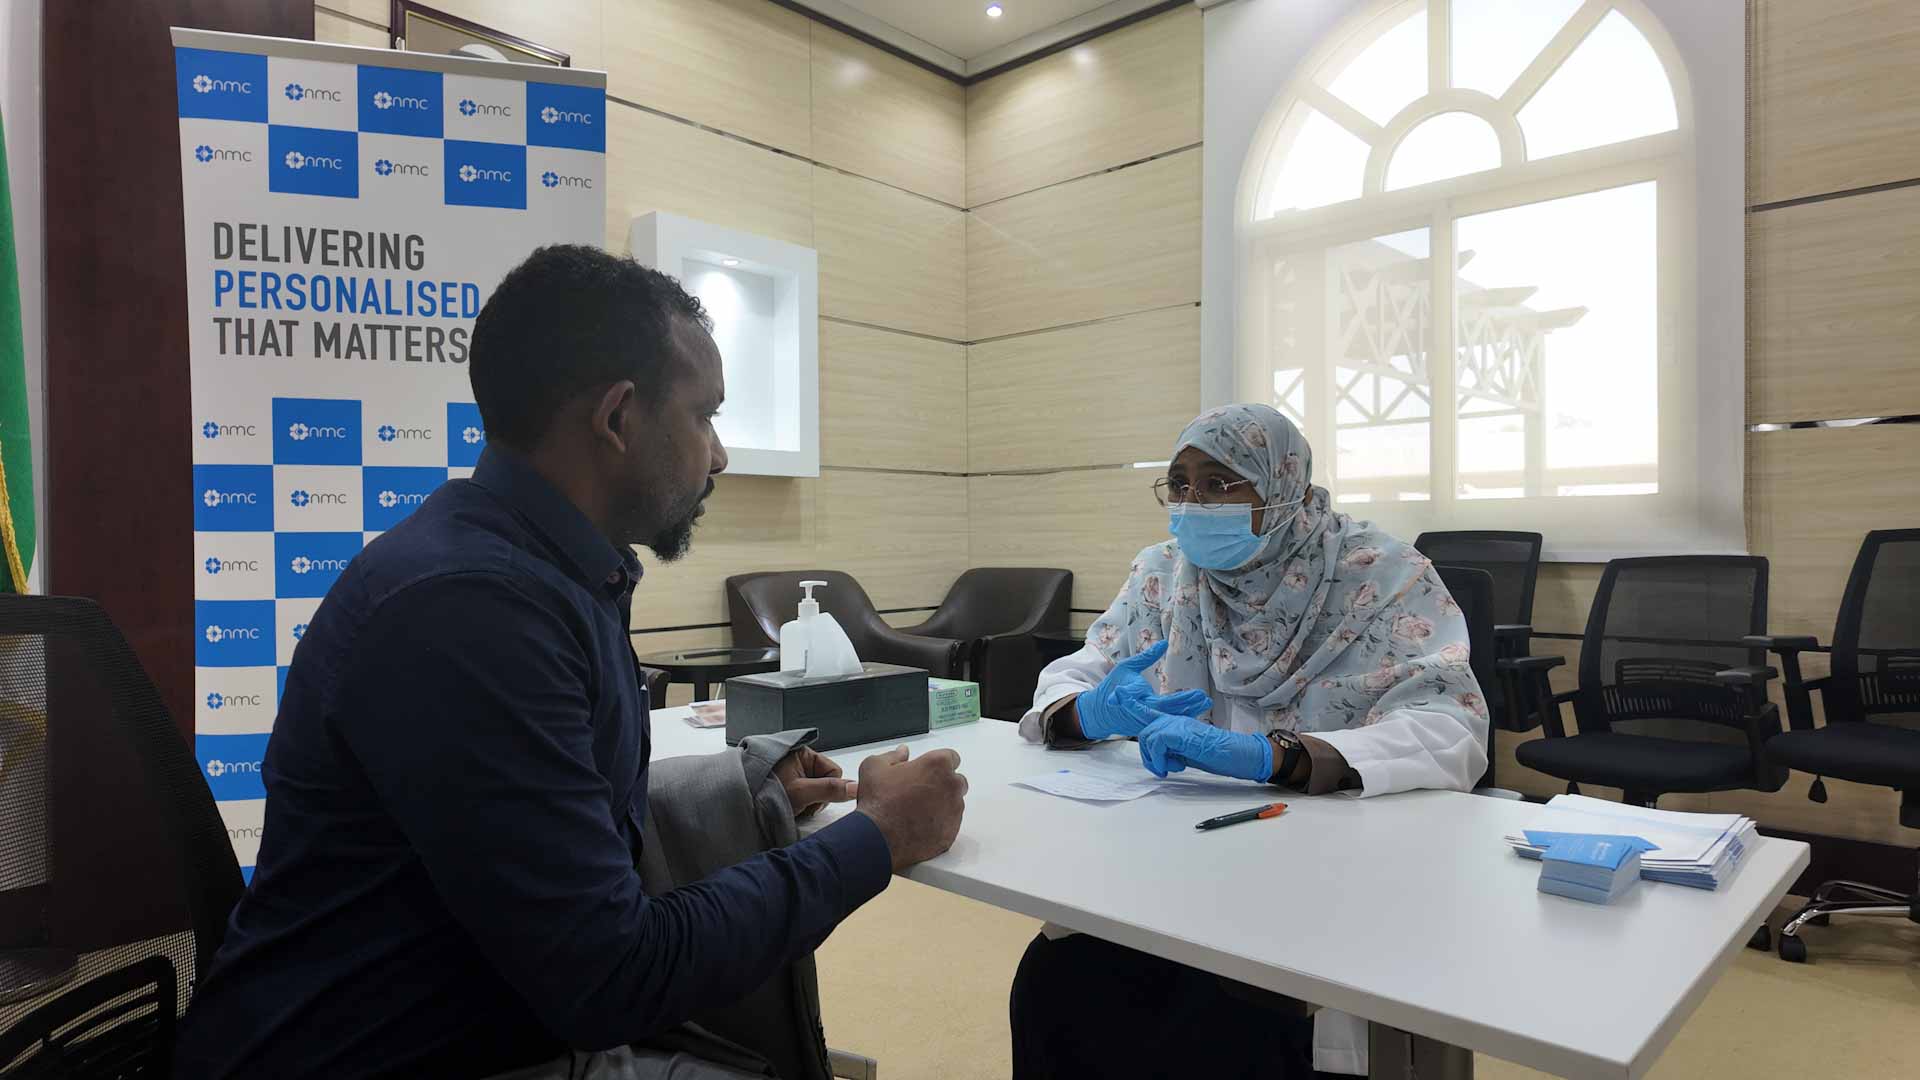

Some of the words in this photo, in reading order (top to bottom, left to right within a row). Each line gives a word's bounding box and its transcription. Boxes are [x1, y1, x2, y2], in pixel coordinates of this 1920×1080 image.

[213, 79, 252, 94] nmc
[304, 88, 341, 102] nmc
[392, 96, 429, 110] nmc
[477, 104, 512, 117] nmc
[558, 111, 592, 125] nmc
[214, 149, 252, 162] nmc
[305, 156, 342, 170] nmc
[393, 162, 429, 177] nmc
[476, 169, 512, 182] nmc
[559, 176, 592, 189] nmc
[213, 221, 425, 271] DELIVERING
[214, 269, 480, 319] PERSONALISED
[213, 317, 299, 358] THAT
[313, 321, 468, 364] MATTERS
[220, 425, 256, 437] nmc
[309, 426, 347, 438] nmc
[396, 428, 432, 440] nmc
[220, 492, 257, 504] nmc
[310, 493, 347, 505] nmc
[222, 560, 258, 572] nmc
[311, 559, 348, 571] nmc
[222, 628, 260, 640] nmc
[223, 695, 261, 707] nmc
[225, 761, 262, 774] nmc
